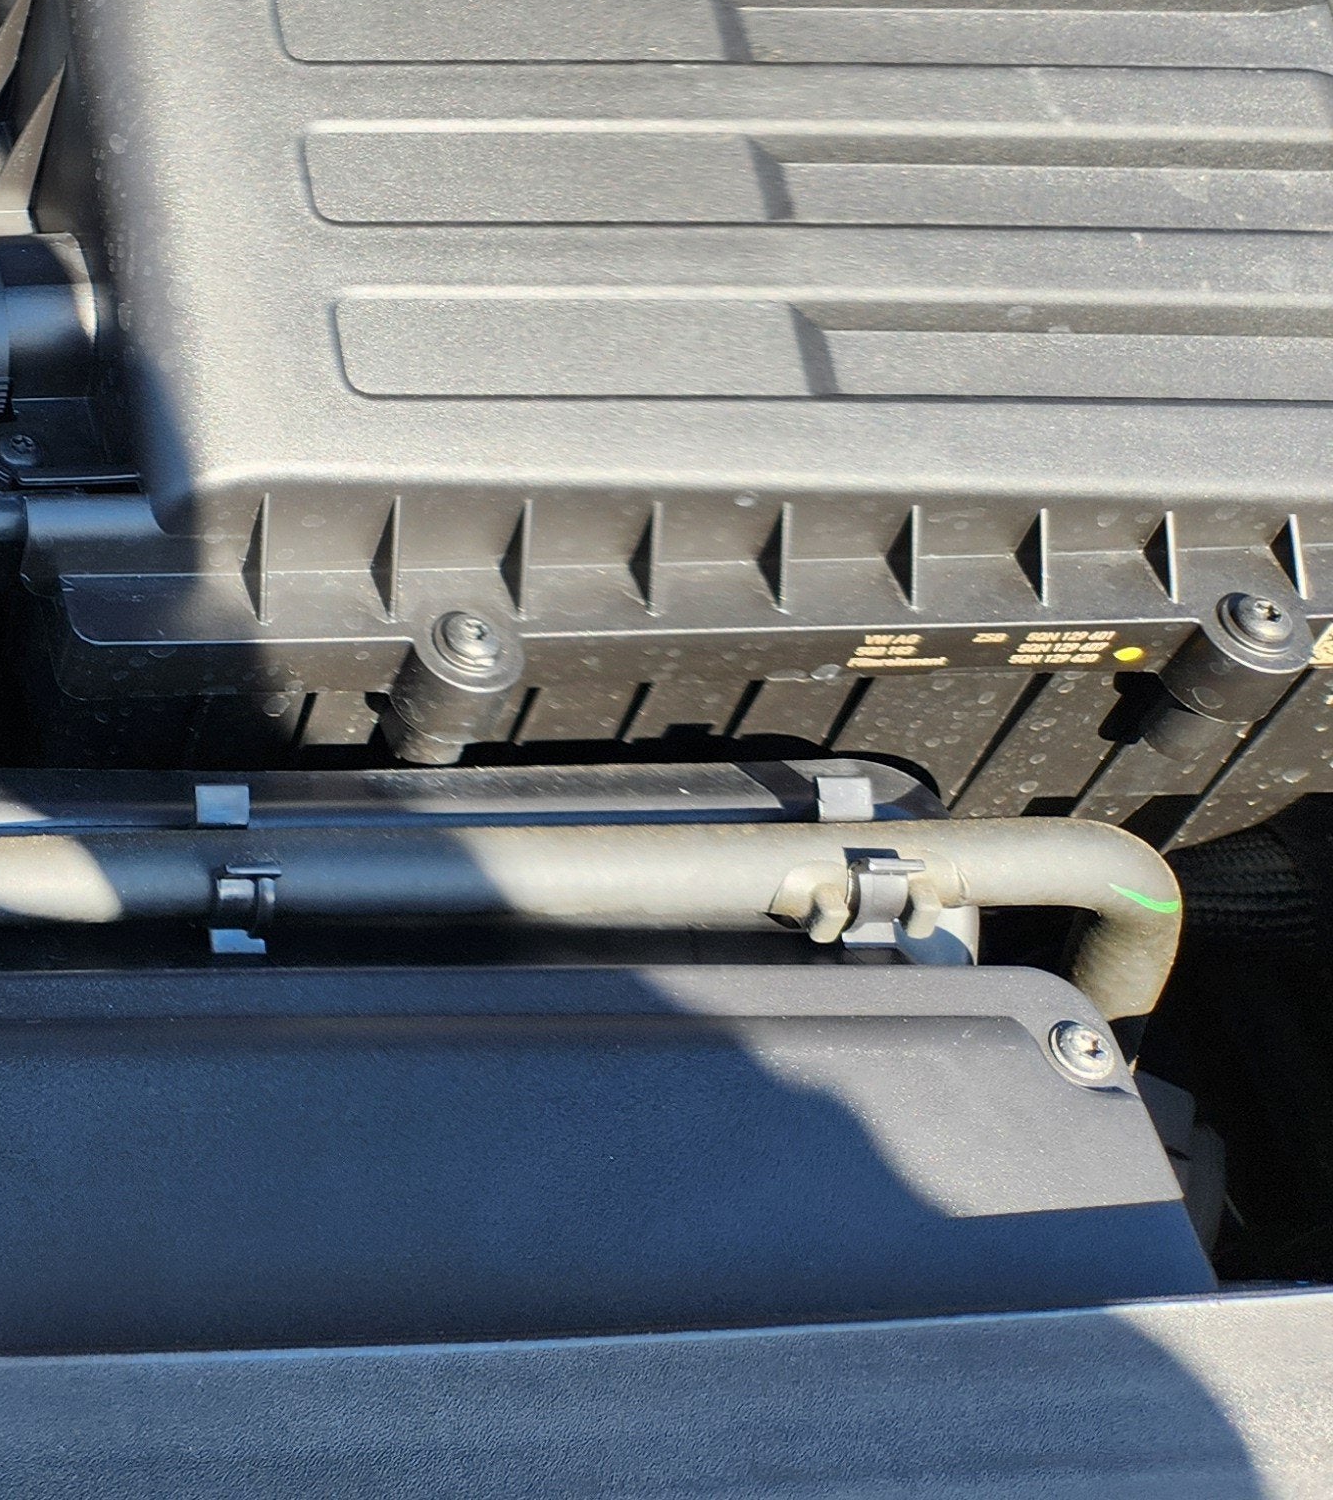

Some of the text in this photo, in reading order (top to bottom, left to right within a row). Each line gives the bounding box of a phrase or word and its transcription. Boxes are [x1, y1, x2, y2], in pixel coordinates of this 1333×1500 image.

[1061, 631, 1090, 641] 129
[1052, 642, 1081, 653] 129
[1043, 653, 1072, 664] 129
